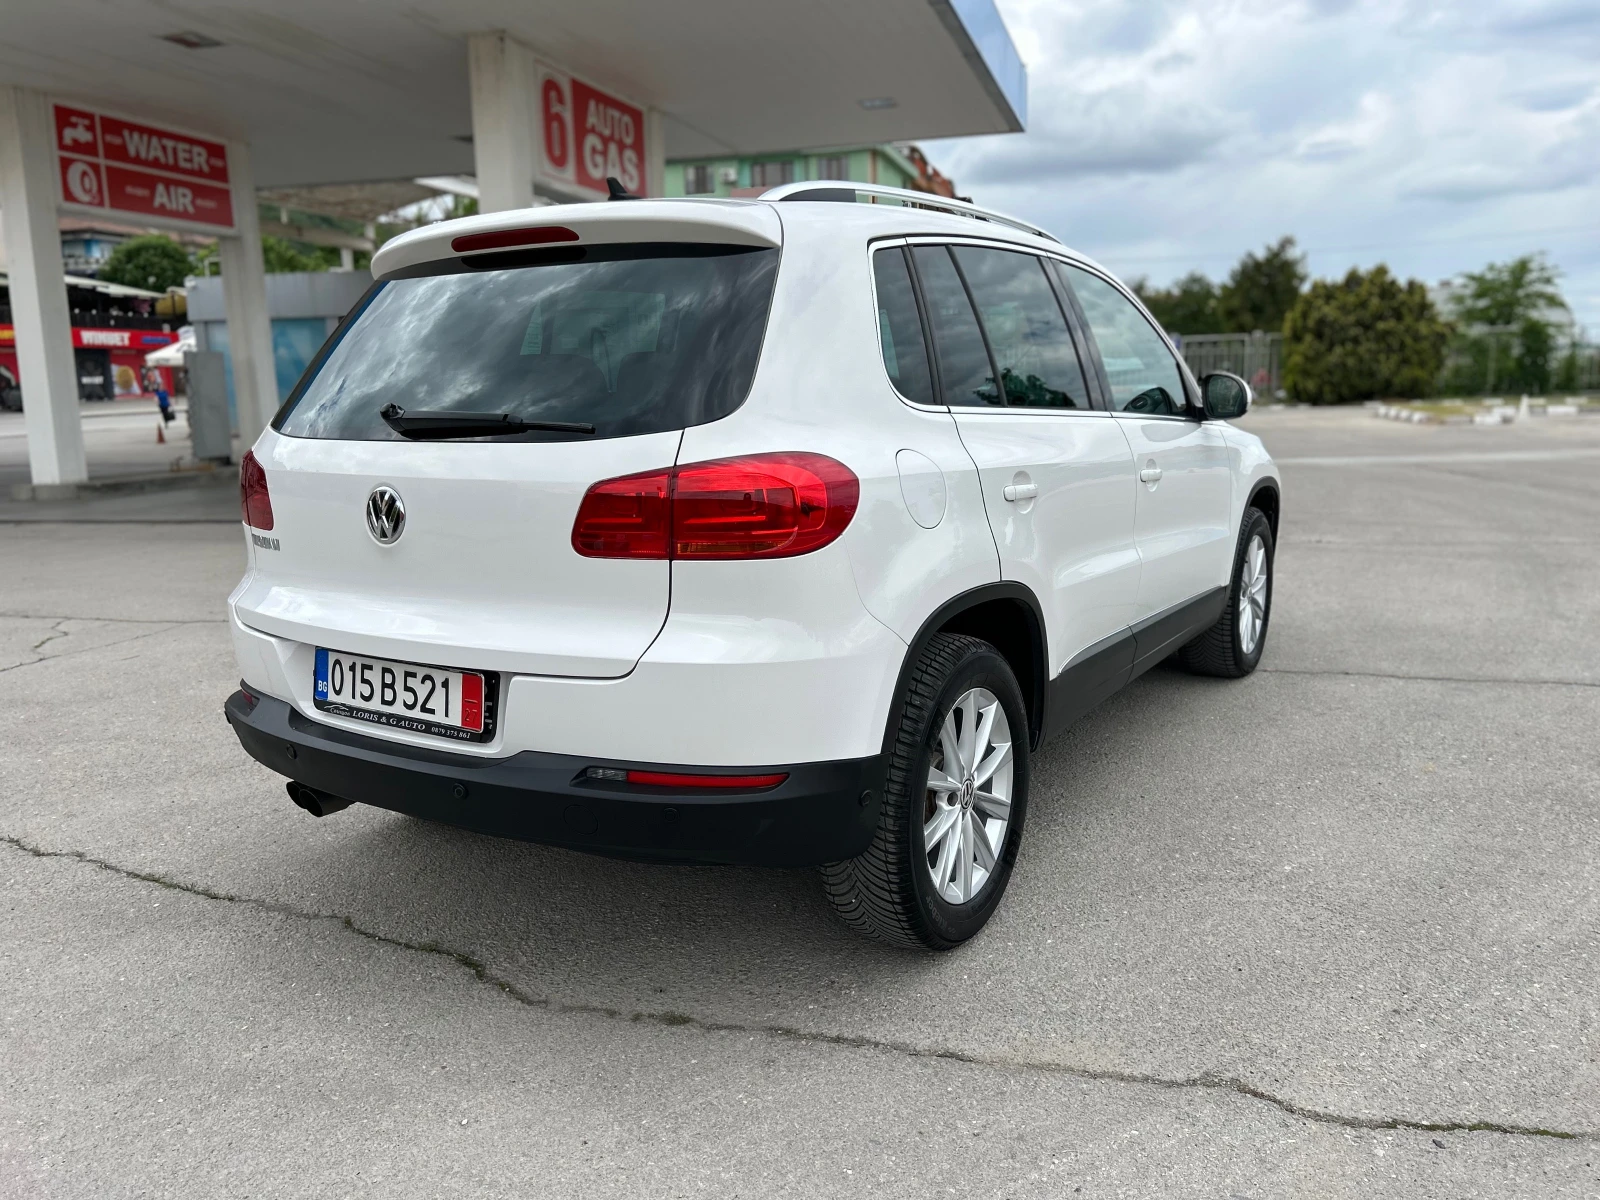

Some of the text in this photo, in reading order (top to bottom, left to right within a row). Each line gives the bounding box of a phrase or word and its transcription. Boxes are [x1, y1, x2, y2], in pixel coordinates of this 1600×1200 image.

[541, 78, 569, 169] 6
[586, 99, 634, 145] AUTO
[122, 128, 210, 174] WATER
[583, 132, 639, 192] GAS
[152, 182, 196, 215] AIR
[318, 680, 328, 692] BG
[352, 710, 378, 722] LORIS
[389, 717, 397, 725] G
[399, 719, 426, 731] AUTO
